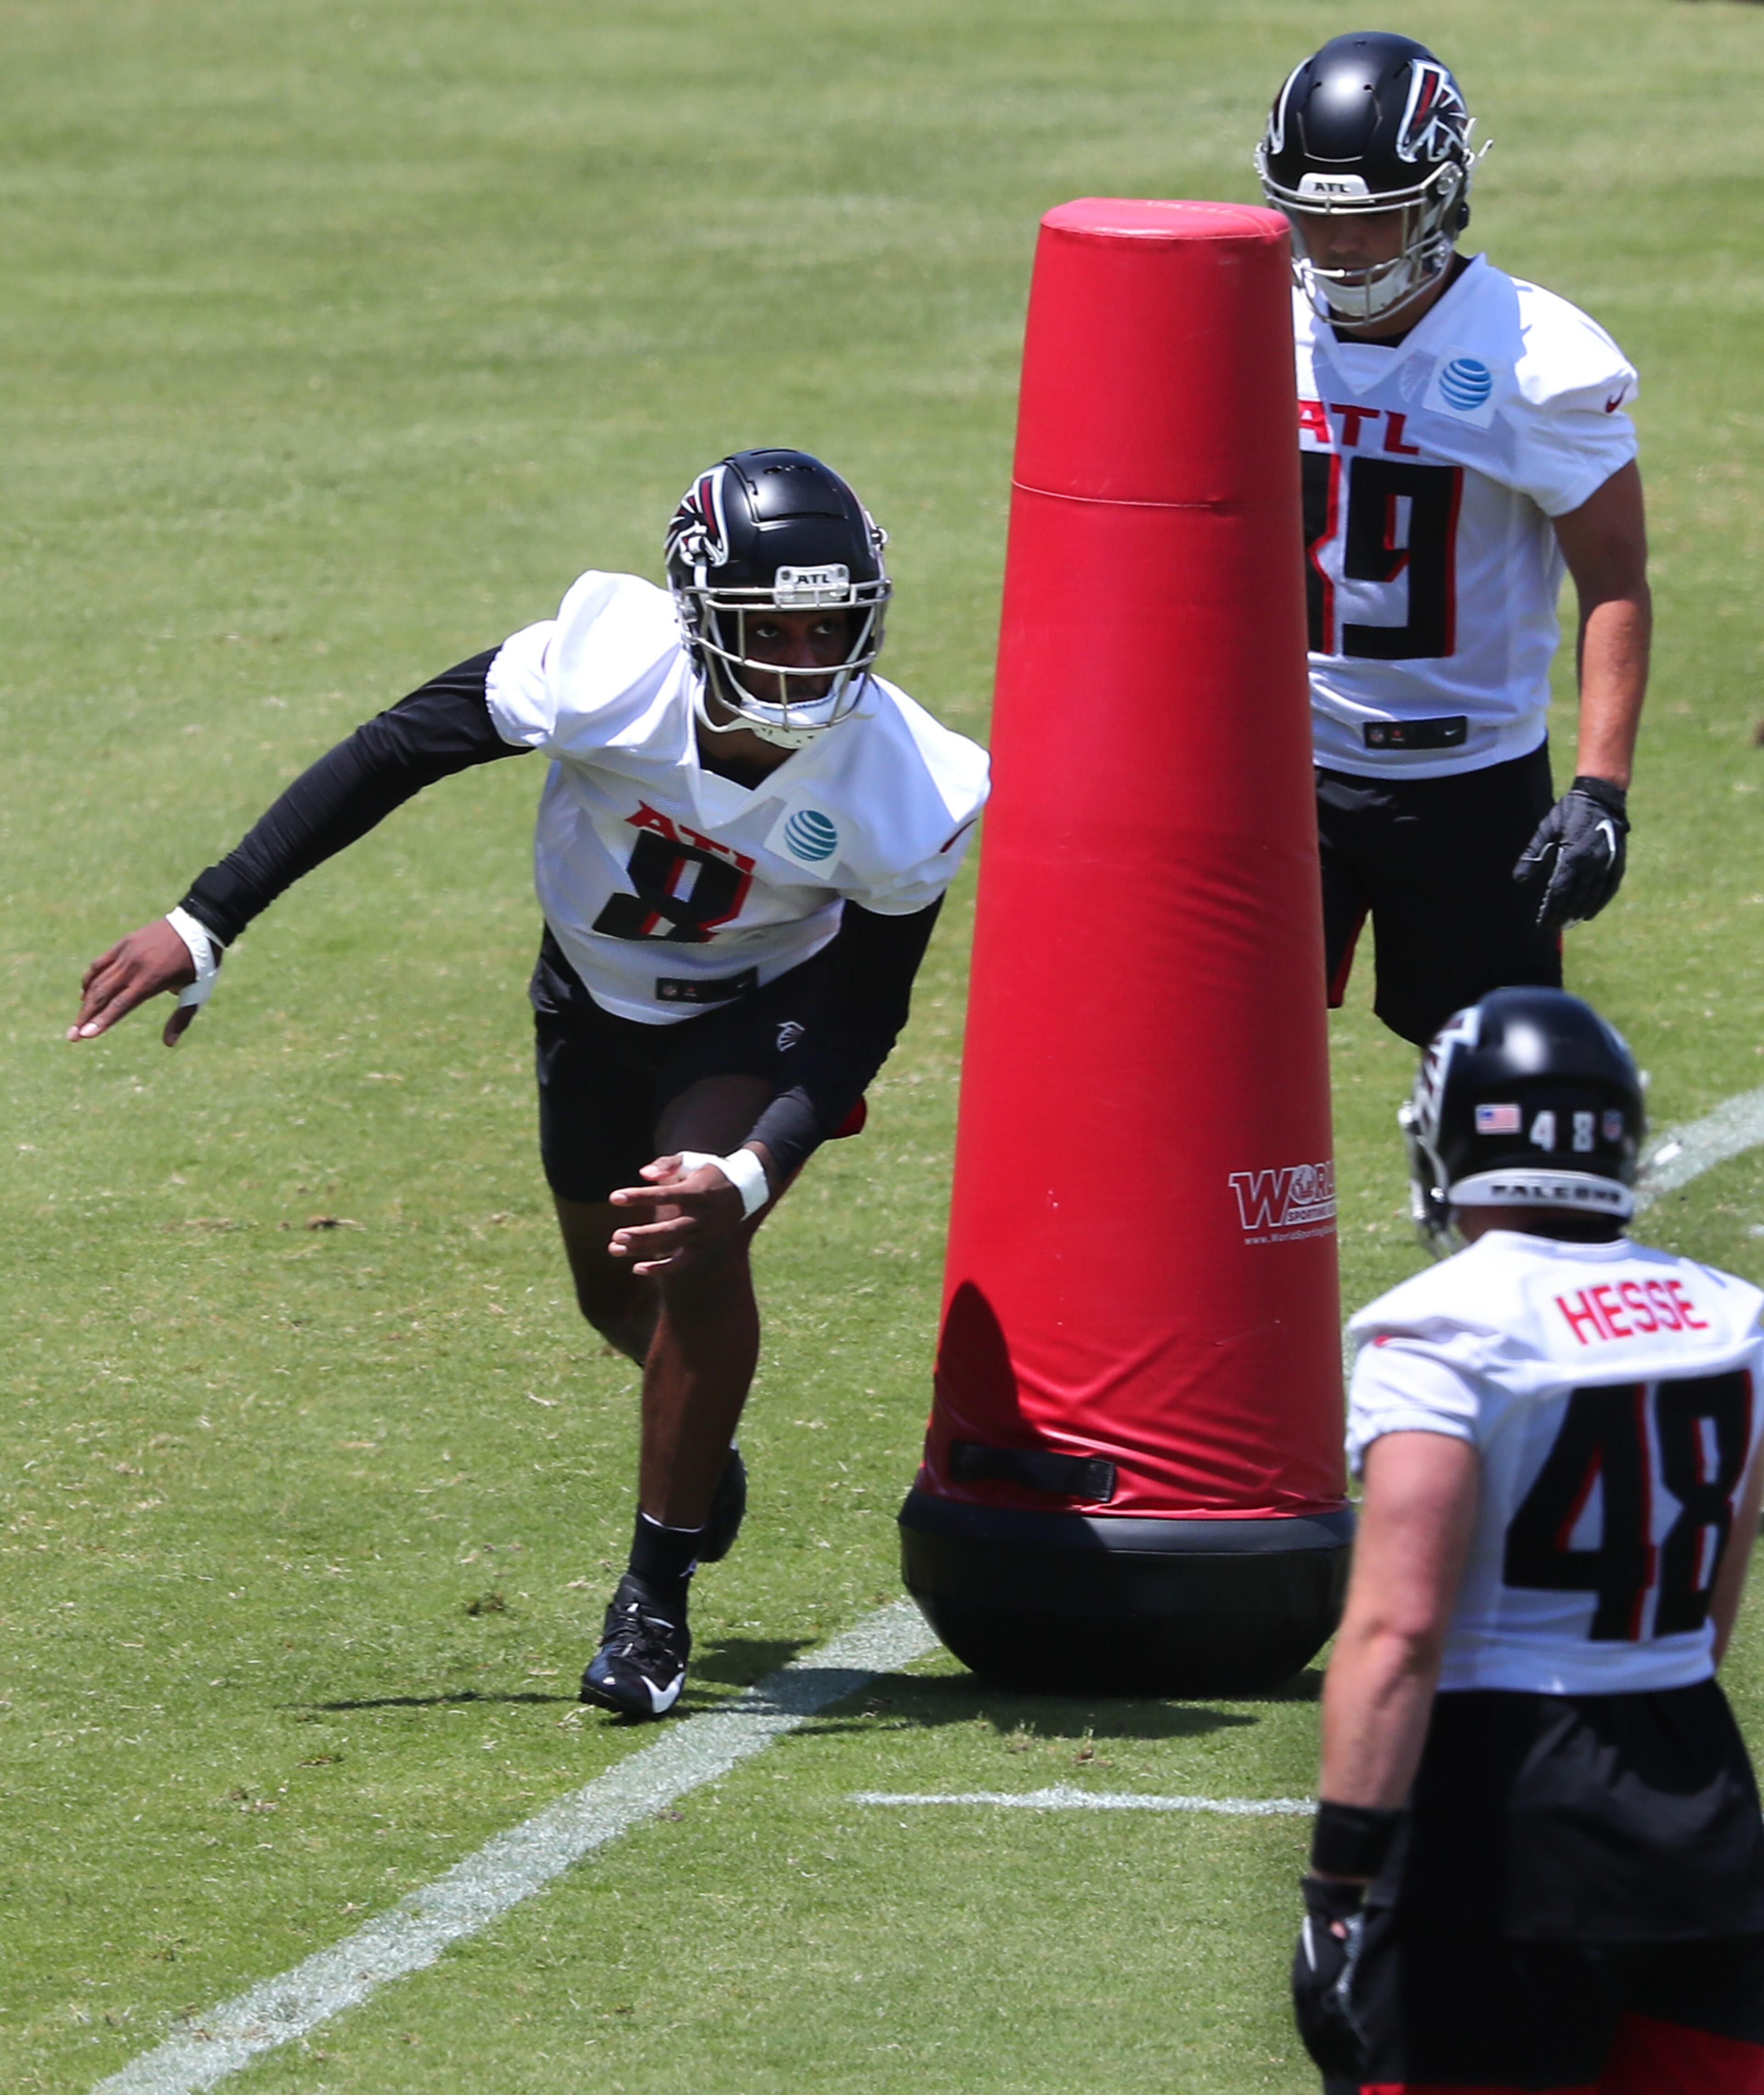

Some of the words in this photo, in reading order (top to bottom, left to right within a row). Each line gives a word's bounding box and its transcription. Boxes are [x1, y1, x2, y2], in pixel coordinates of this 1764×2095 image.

[1314, 182, 1351, 193] ATL
[1298, 401, 1419, 455] ATL
[795, 573, 830, 584] ATL
[1530, 1110, 1594, 1152] 48
[1555, 1280, 1709, 1345] HESSE
[1503, 1369, 1753, 1642] 48
